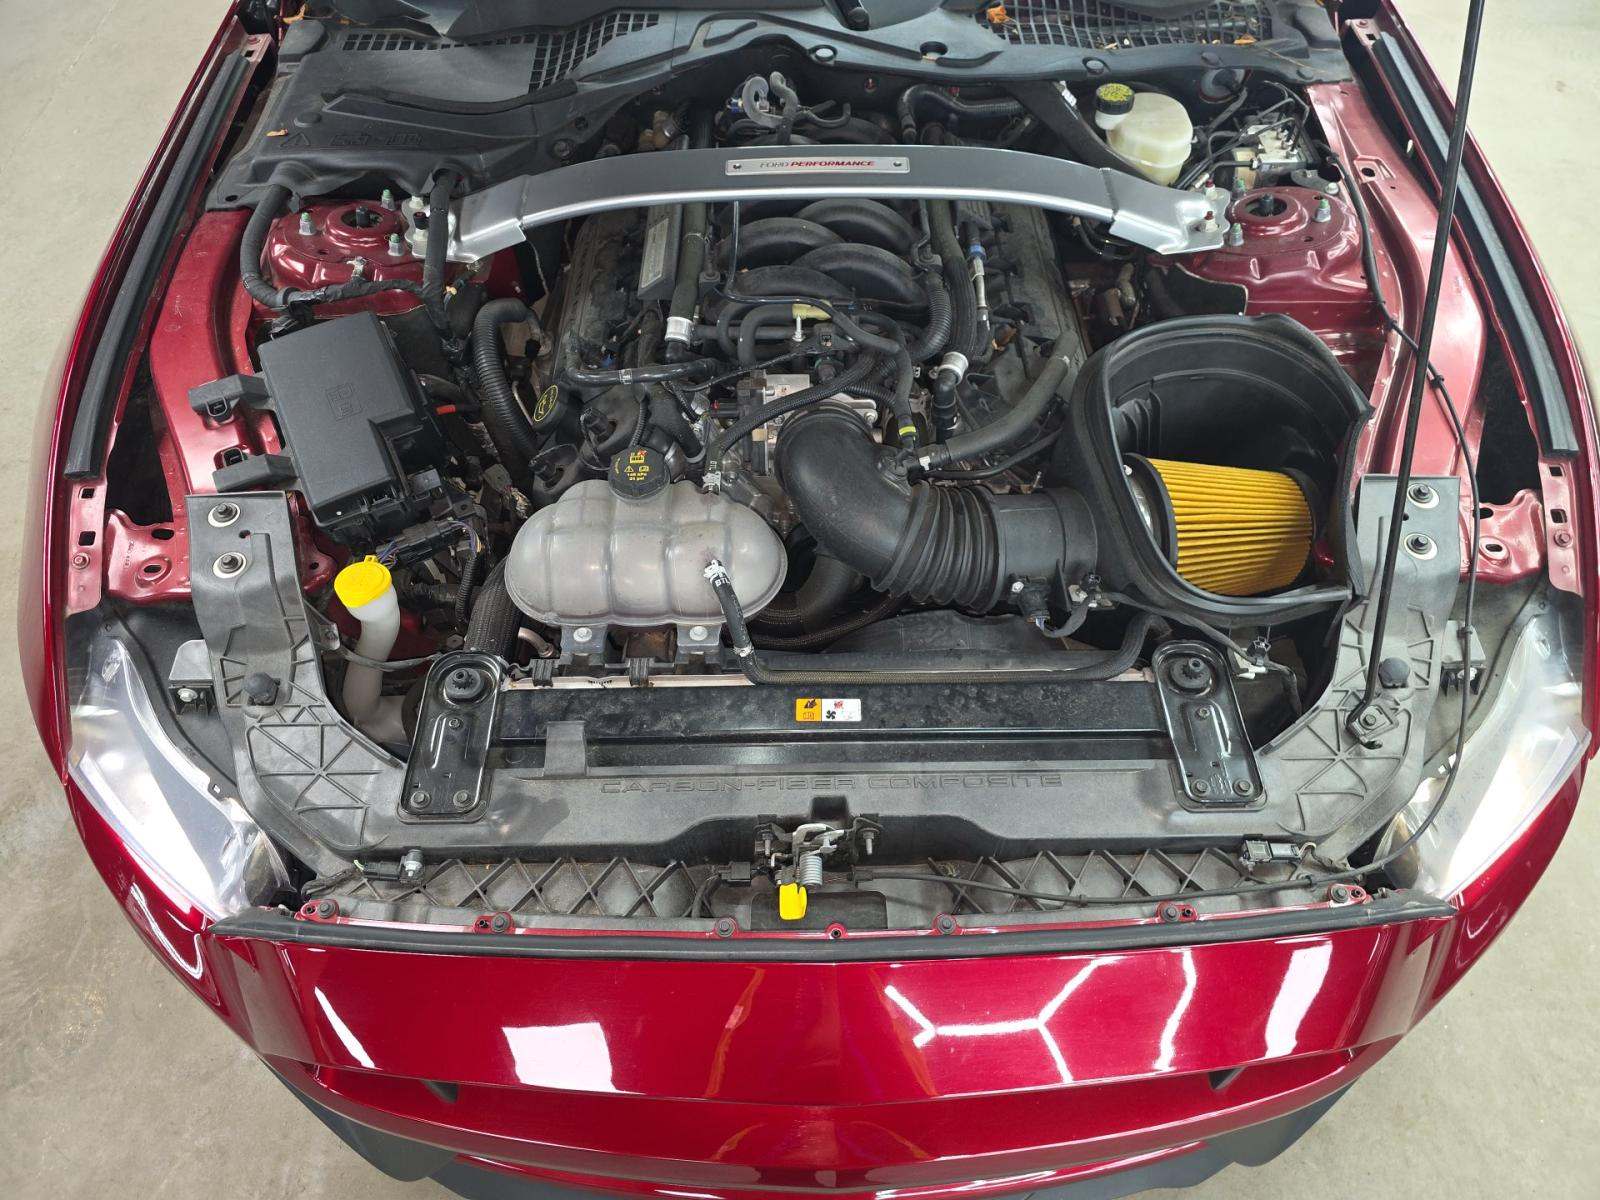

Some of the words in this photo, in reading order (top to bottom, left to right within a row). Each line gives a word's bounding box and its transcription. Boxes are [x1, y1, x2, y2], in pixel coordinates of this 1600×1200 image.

[760, 161, 789, 169] FORD
[790, 160, 876, 168] PERFORMANCE
[600, 777, 856, 793] CARBON-FIBER
[868, 774, 1063, 790] COMPOSITE
